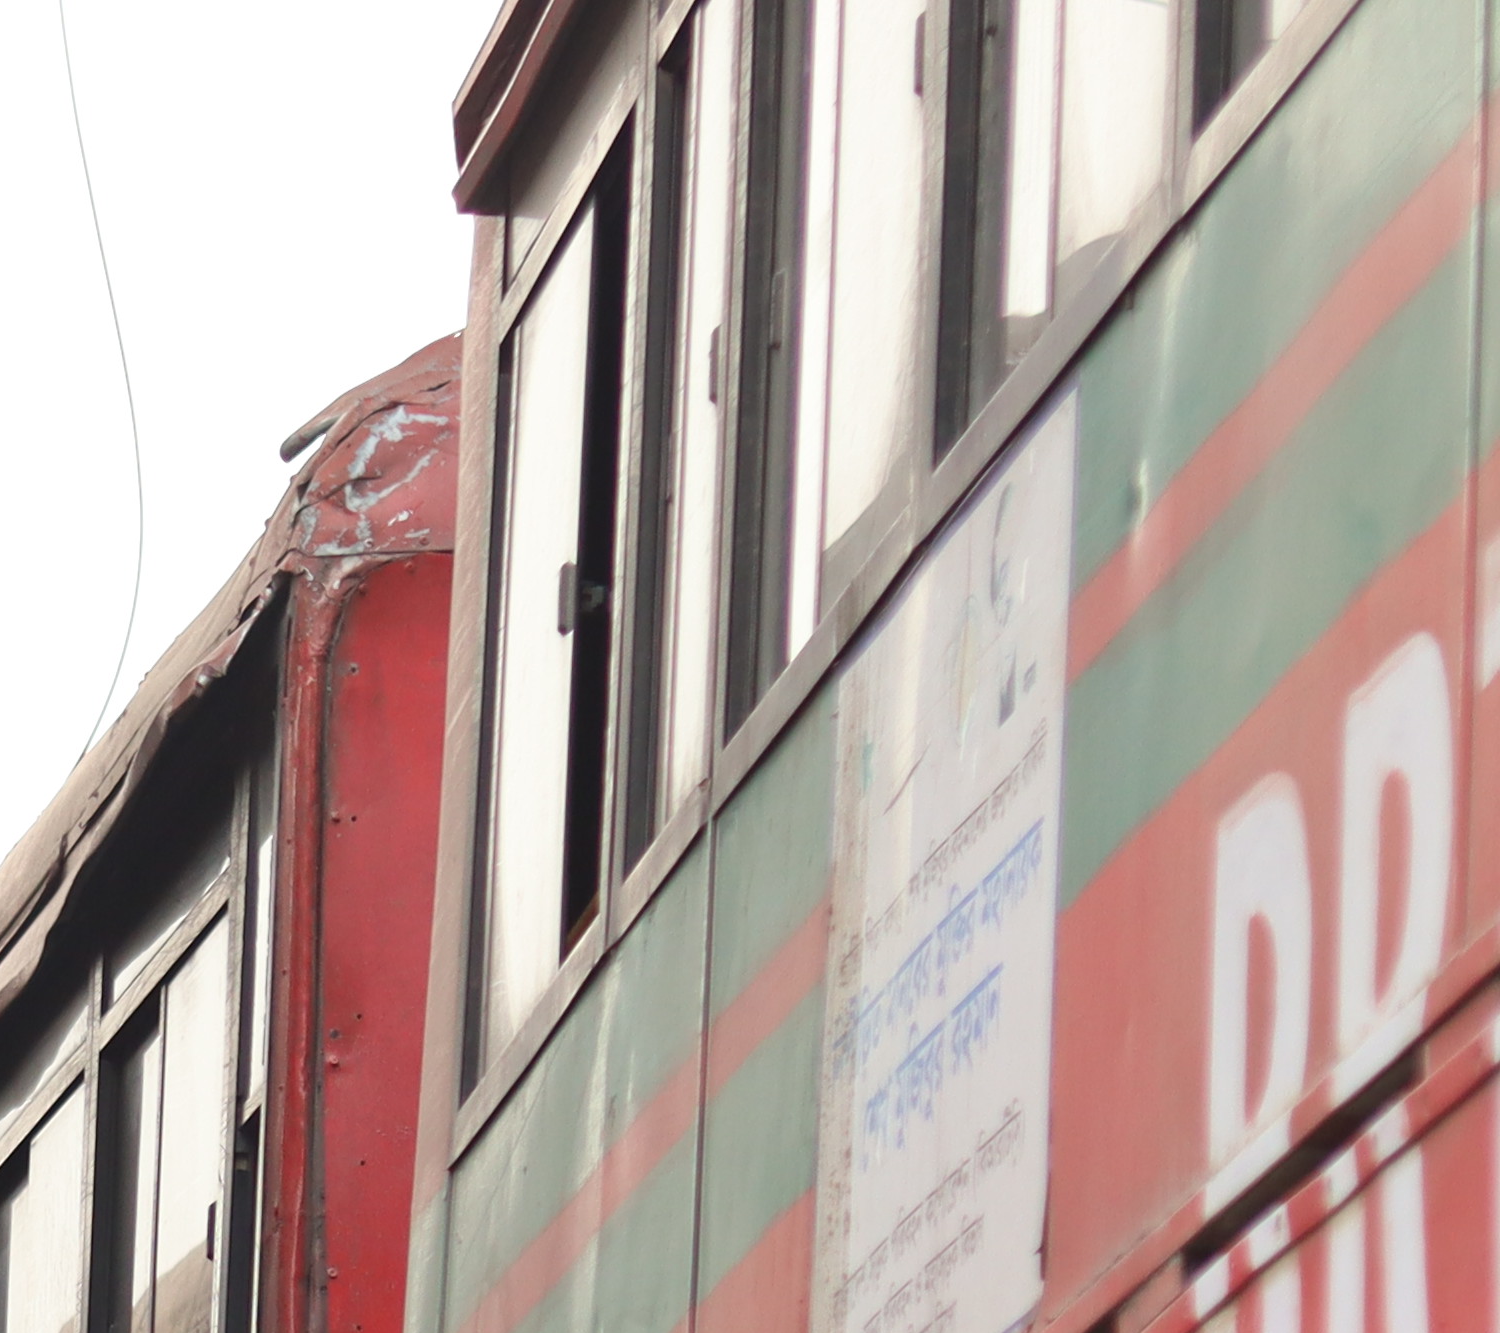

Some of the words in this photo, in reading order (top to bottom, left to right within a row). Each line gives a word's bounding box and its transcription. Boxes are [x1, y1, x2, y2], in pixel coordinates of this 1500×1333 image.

[981, 818, 1044, 932] মহানায়ক
[894, 1018, 944, 1151] মুজিবুর
[950, 965, 1003, 1076] রহমান
